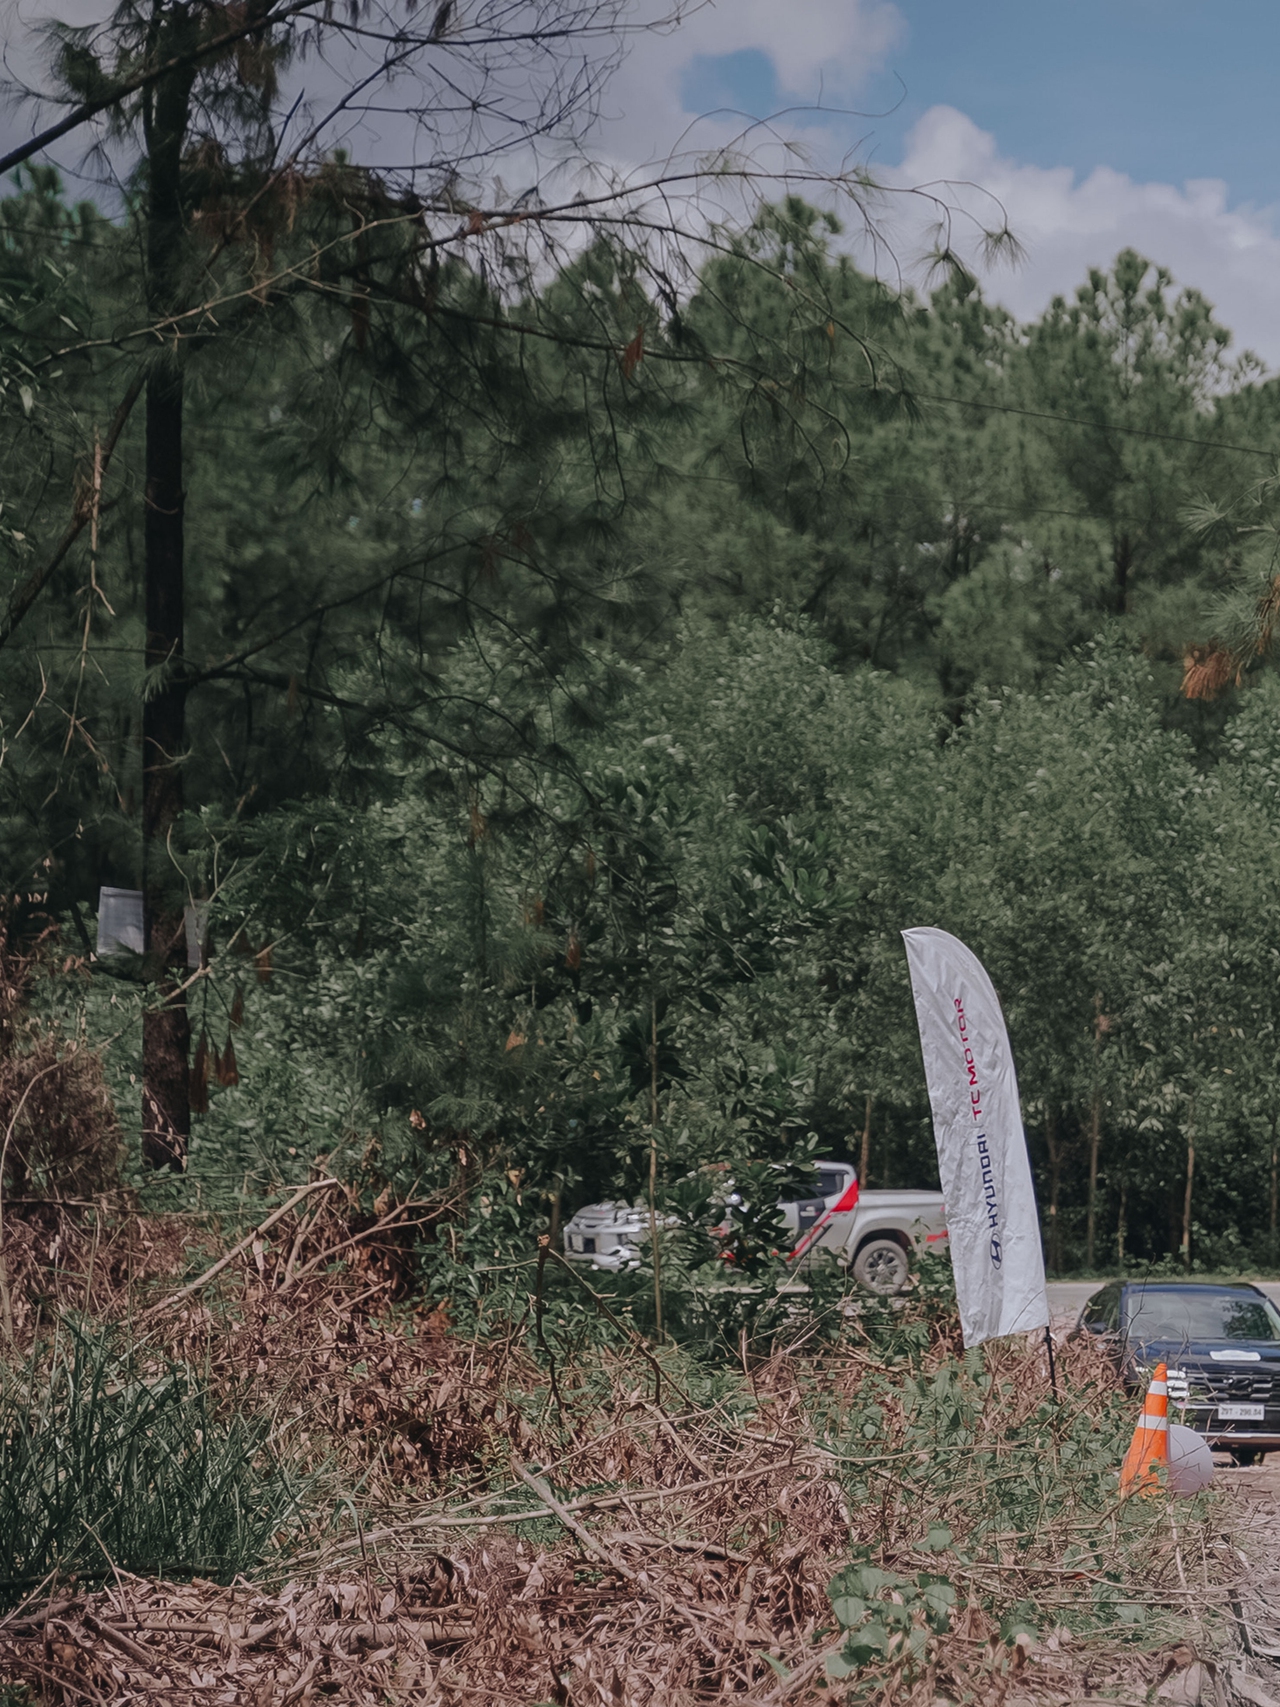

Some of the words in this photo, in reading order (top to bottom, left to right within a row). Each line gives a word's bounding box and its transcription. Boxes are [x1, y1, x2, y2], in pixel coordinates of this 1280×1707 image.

[953, 997, 979, 1087] MOTOR
[969, 1090, 983, 1121] TC
[976, 1133, 998, 1229] HYUNDAI
